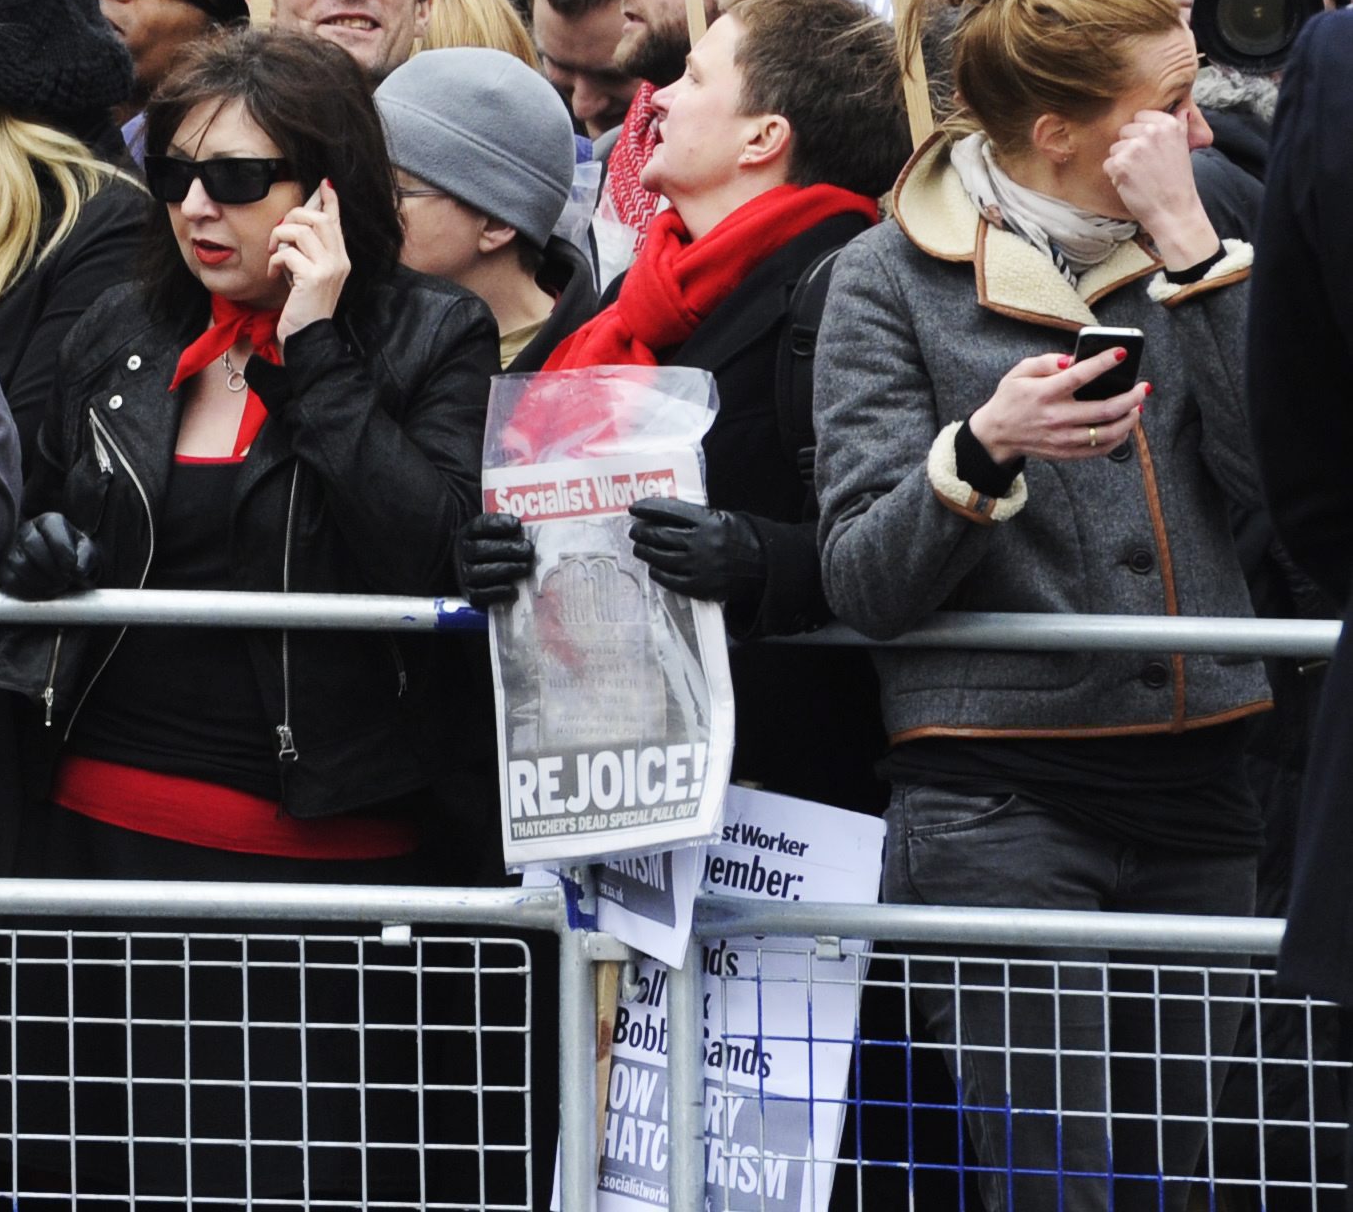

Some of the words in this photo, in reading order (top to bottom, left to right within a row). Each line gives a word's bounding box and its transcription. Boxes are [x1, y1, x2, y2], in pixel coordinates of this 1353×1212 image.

[495, 478, 592, 518] Socialist
[595, 473, 674, 508] Worker
[509, 742, 707, 819] REJOICE!
[512, 816, 576, 838] THATCHER'S
[578, 813, 608, 831] DEAD
[609, 809, 650, 829] SPECIAL
[651, 805, 675, 822] PULL
[676, 801, 698, 818] OUT
[742, 824, 809, 857] Worker
[704, 854, 804, 901] ember:
[613, 1007, 668, 1055] Bobb
[704, 1026, 773, 1078] ands
[609, 1063, 658, 1116] OW
